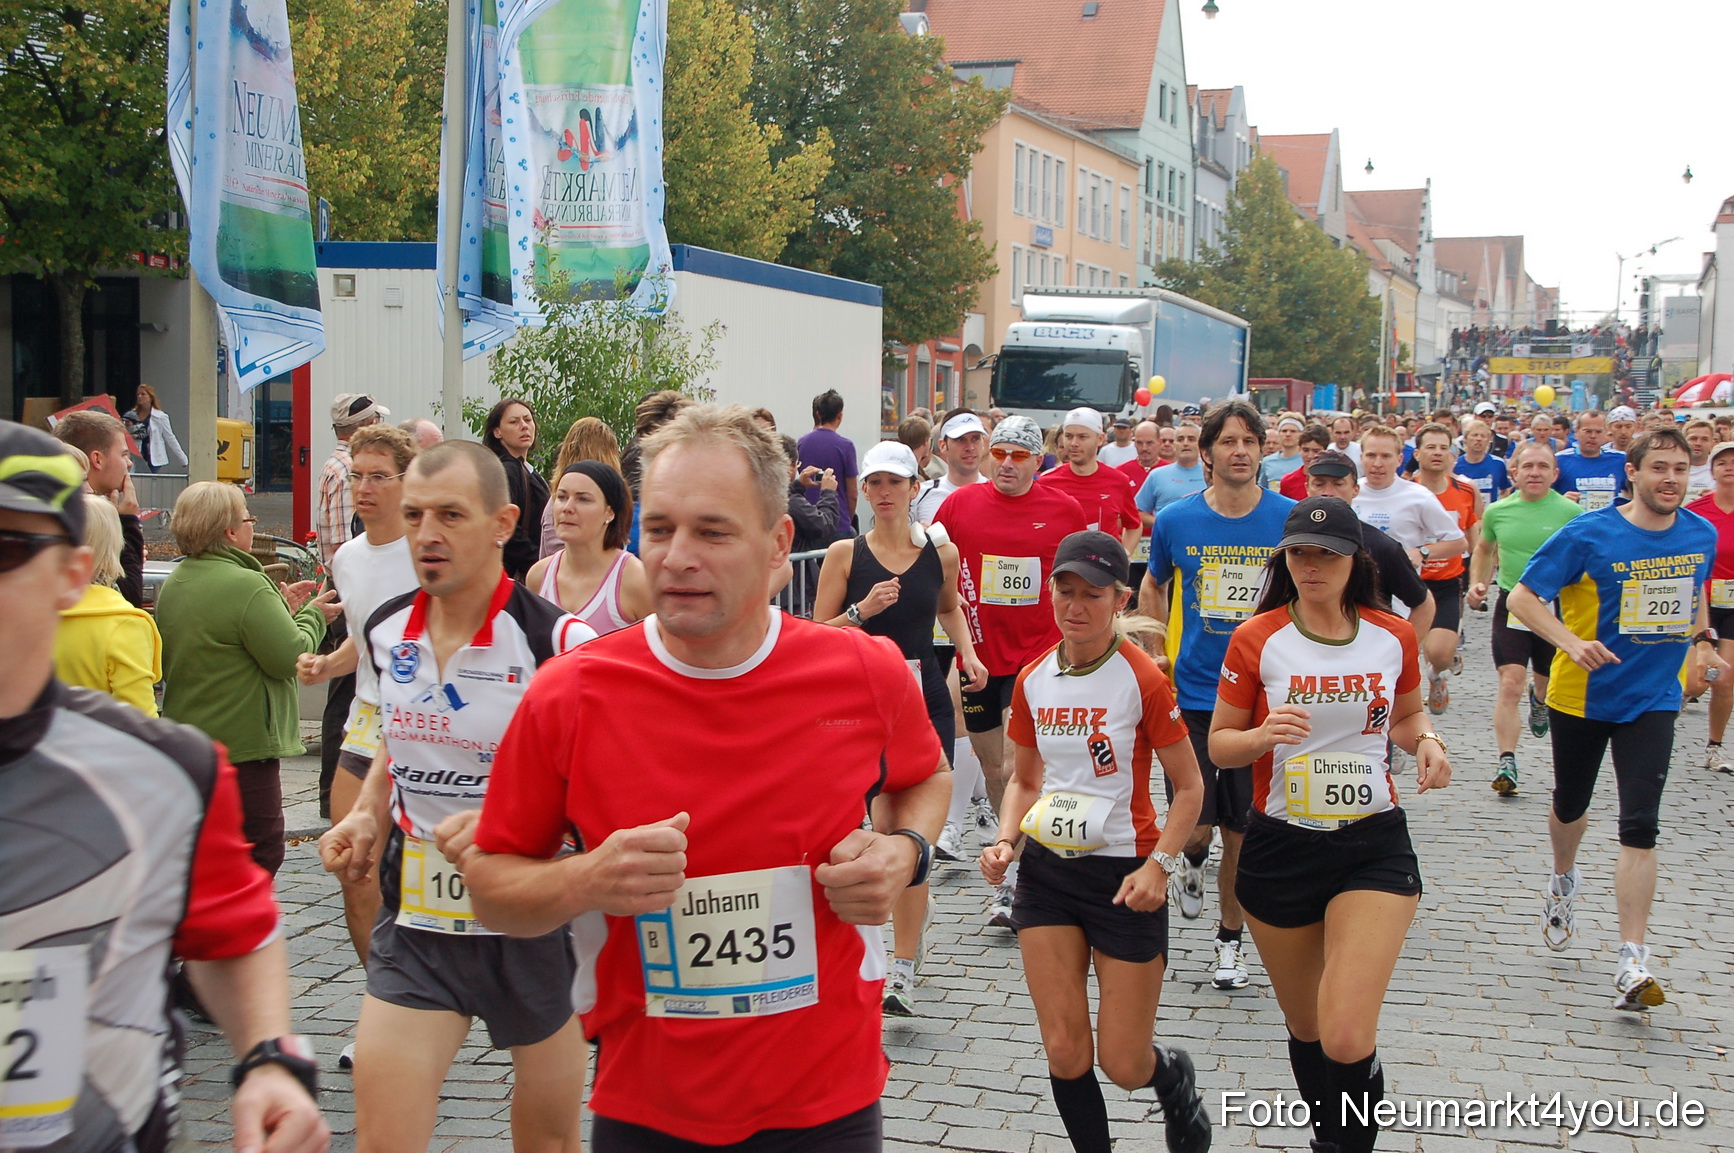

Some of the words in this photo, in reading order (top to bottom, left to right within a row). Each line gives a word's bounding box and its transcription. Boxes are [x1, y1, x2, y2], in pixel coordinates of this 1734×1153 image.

[233, 80, 303, 150] NEUM
[245, 140, 306, 181] MINERAL
[1033, 326, 1095, 339] BOCK
[1527, 360, 1570, 371] START
[1185, 546, 1200, 556] 10.
[998, 560, 1019, 572] Samy
[1221, 568, 1243, 580] Arno
[1611, 562, 1629, 573] 10.
[1629, 564, 1697, 581] STADTLAUF
[1003, 576, 1031, 590] 860
[1642, 584, 1677, 595] Torsten
[1227, 586, 1260, 601] 227
[1648, 600, 1681, 616] 202
[970, 605, 983, 643] MAX
[1290, 672, 1386, 694] MERZ
[1284, 688, 1369, 705] Reisen
[390, 706, 451, 733] ARBER
[1037, 707, 1108, 726] MERZ
[1314, 758, 1372, 774] Christina
[1050, 795, 1078, 812] Sonja
[1325, 784, 1373, 806] 509
[1051, 816, 1088, 840] 511
[432, 872, 471, 901] 10
[682, 889, 760, 916] Johann
[688, 922, 796, 968] 2435
[752, 983, 815, 1005] PFLEIDERER
[3, 1029, 39, 1081] 2
